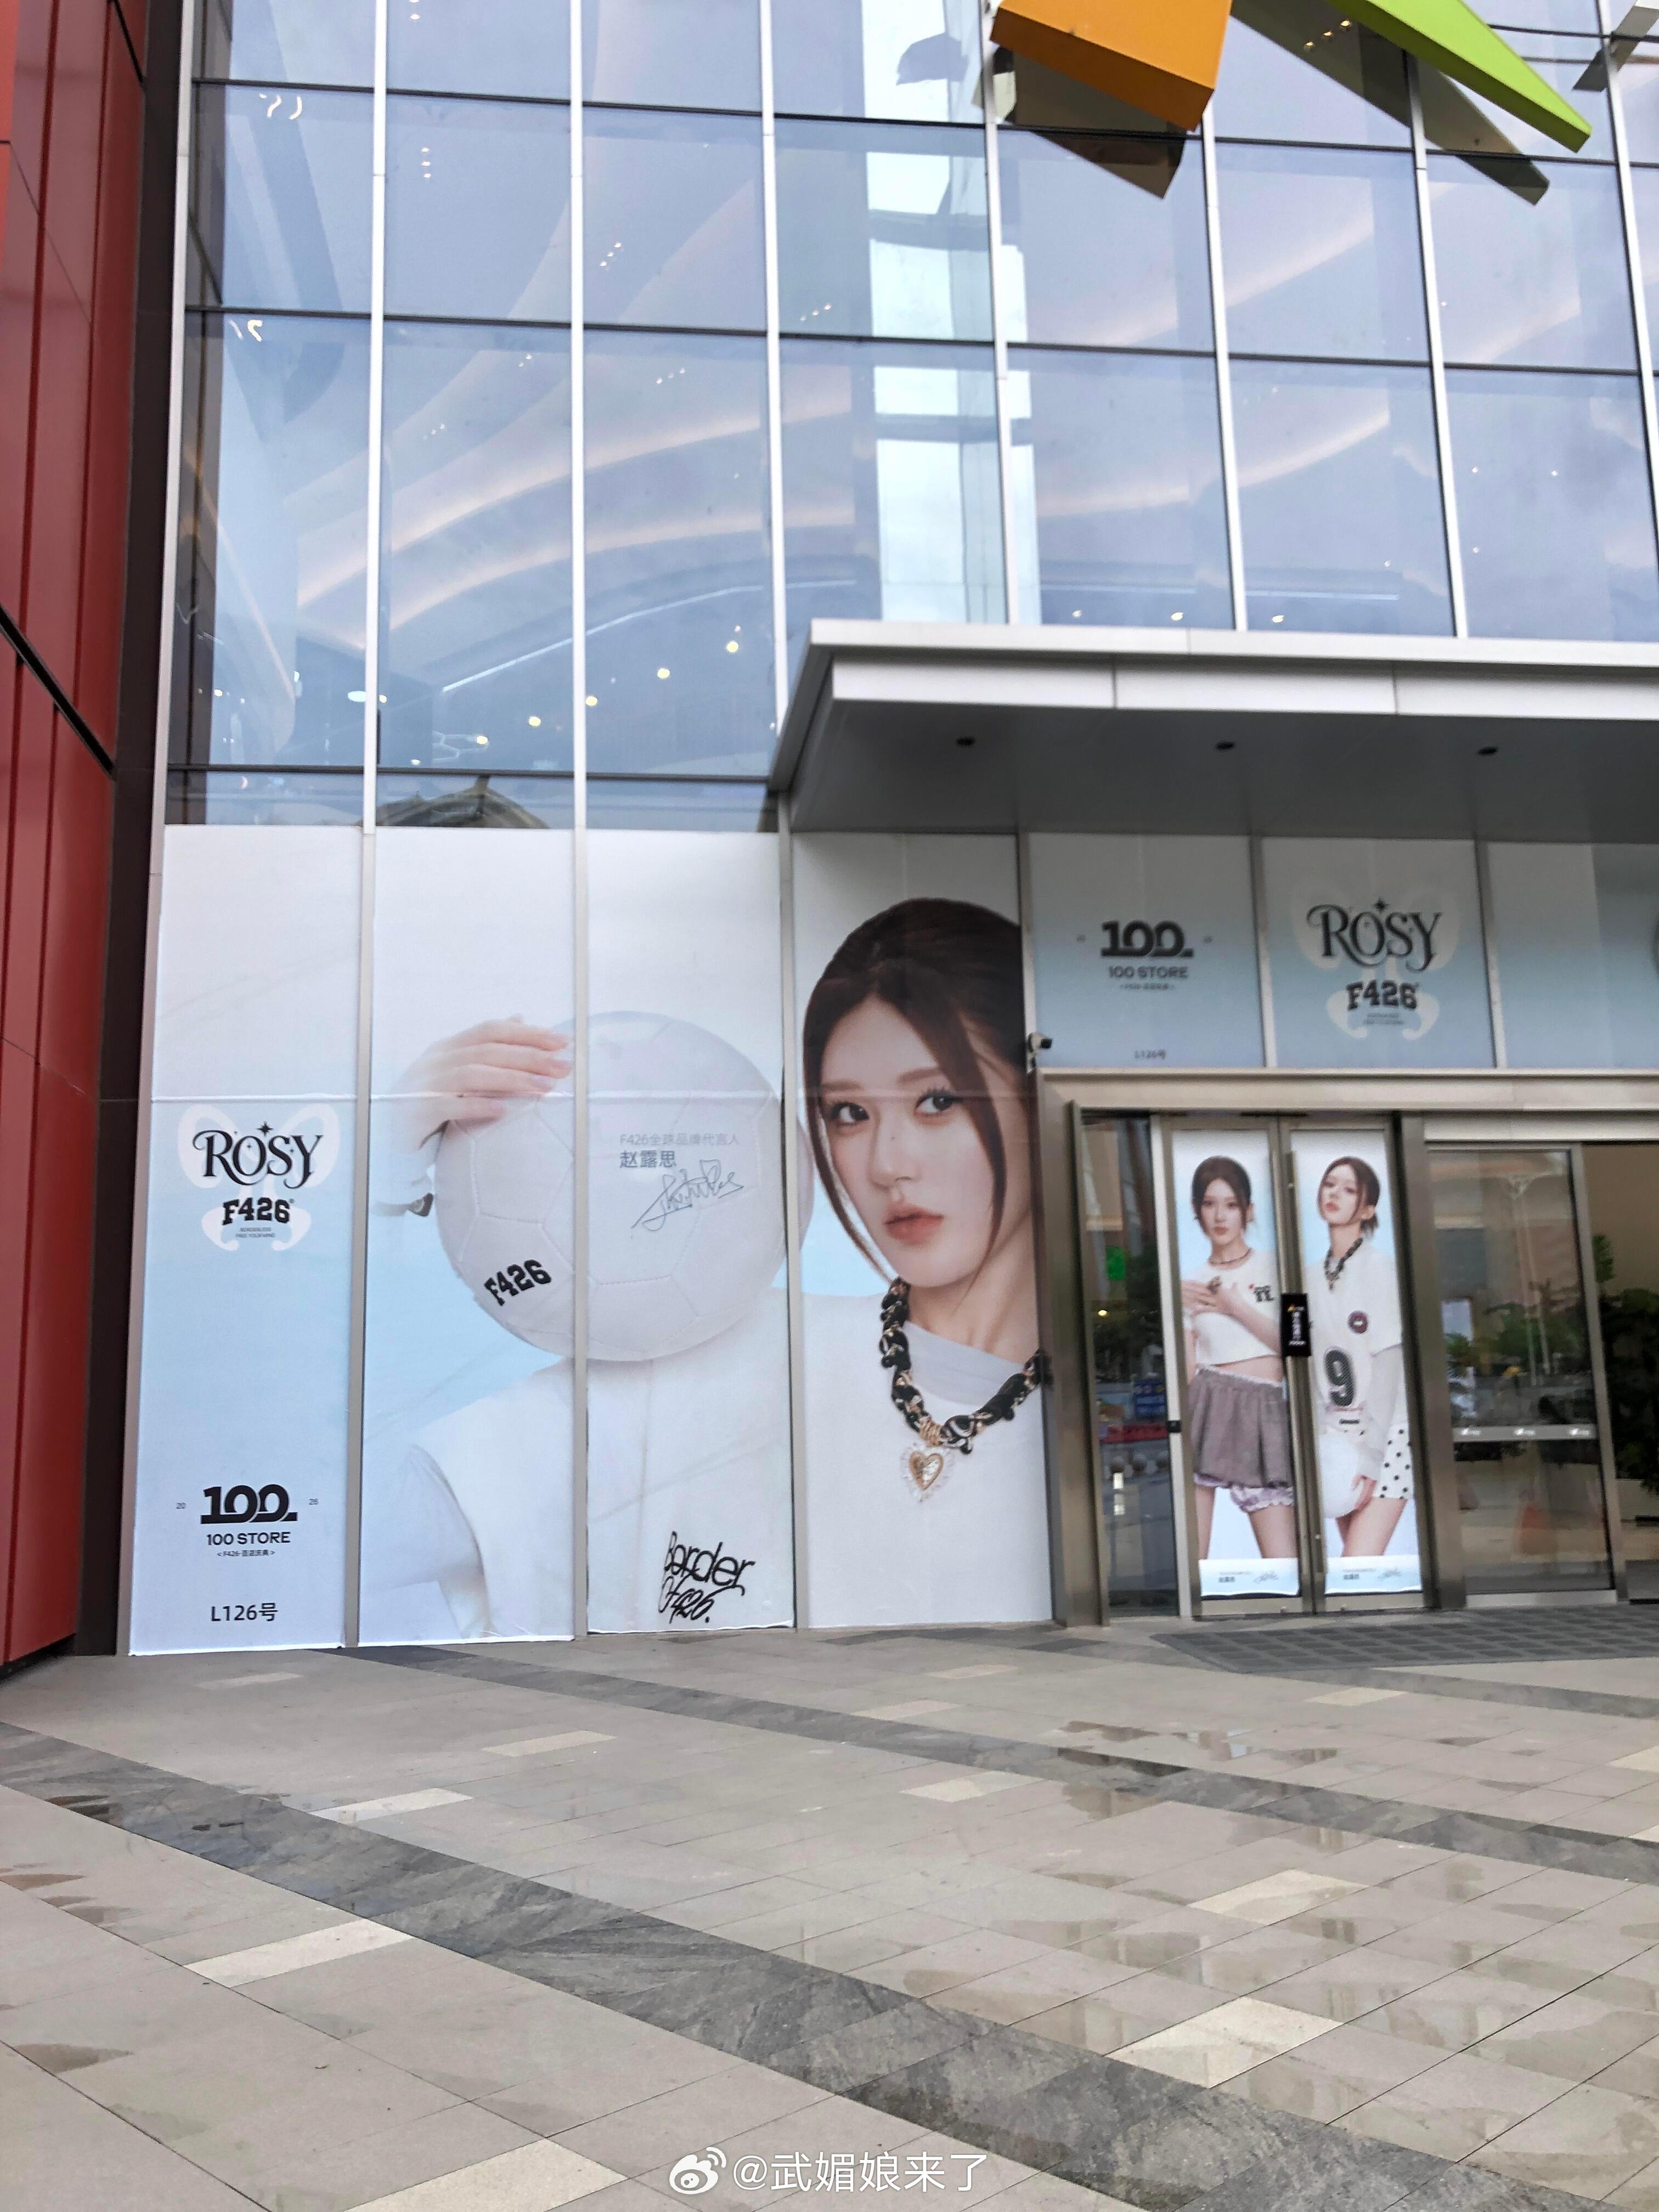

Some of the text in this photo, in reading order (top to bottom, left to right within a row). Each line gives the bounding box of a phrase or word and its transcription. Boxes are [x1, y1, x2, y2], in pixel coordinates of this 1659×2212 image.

[1101, 920, 1194, 957] 100
[1306, 904, 1442, 972] ROSY
[1109, 966, 1188, 978] 100 STORE
[1346, 979, 1418, 1011] F426
[193, 1130, 323, 1189] ROSY
[619, 1150, 677, 1168] 赵露思
[222, 1197, 290, 1226] F426
[484, 1259, 551, 1306] F426
[200, 1483, 298, 1524] 100
[207, 1532, 291, 1545] 100 STORE
[211, 1602, 278, 1622] L126号
